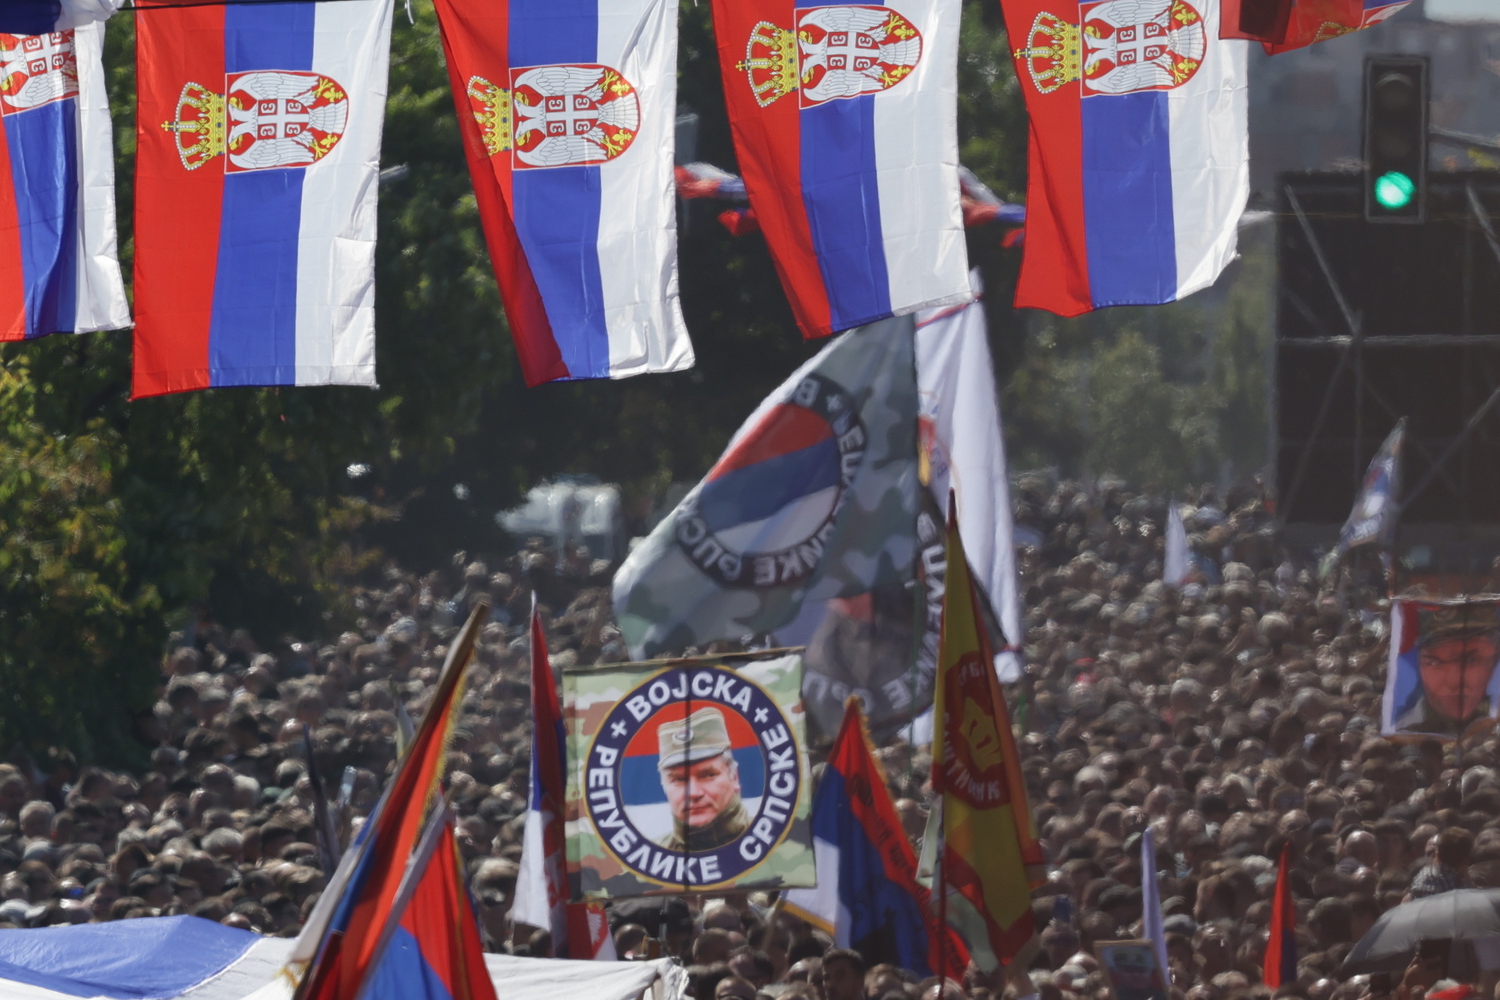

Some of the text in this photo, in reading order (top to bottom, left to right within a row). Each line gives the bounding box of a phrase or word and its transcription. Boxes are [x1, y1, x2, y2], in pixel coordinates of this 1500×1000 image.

[625, 671, 752, 722] ВОЈСКА
[589, 744, 722, 883] РЕПУБЛИКЕ
[739, 723, 796, 861] СРПСКЕ
